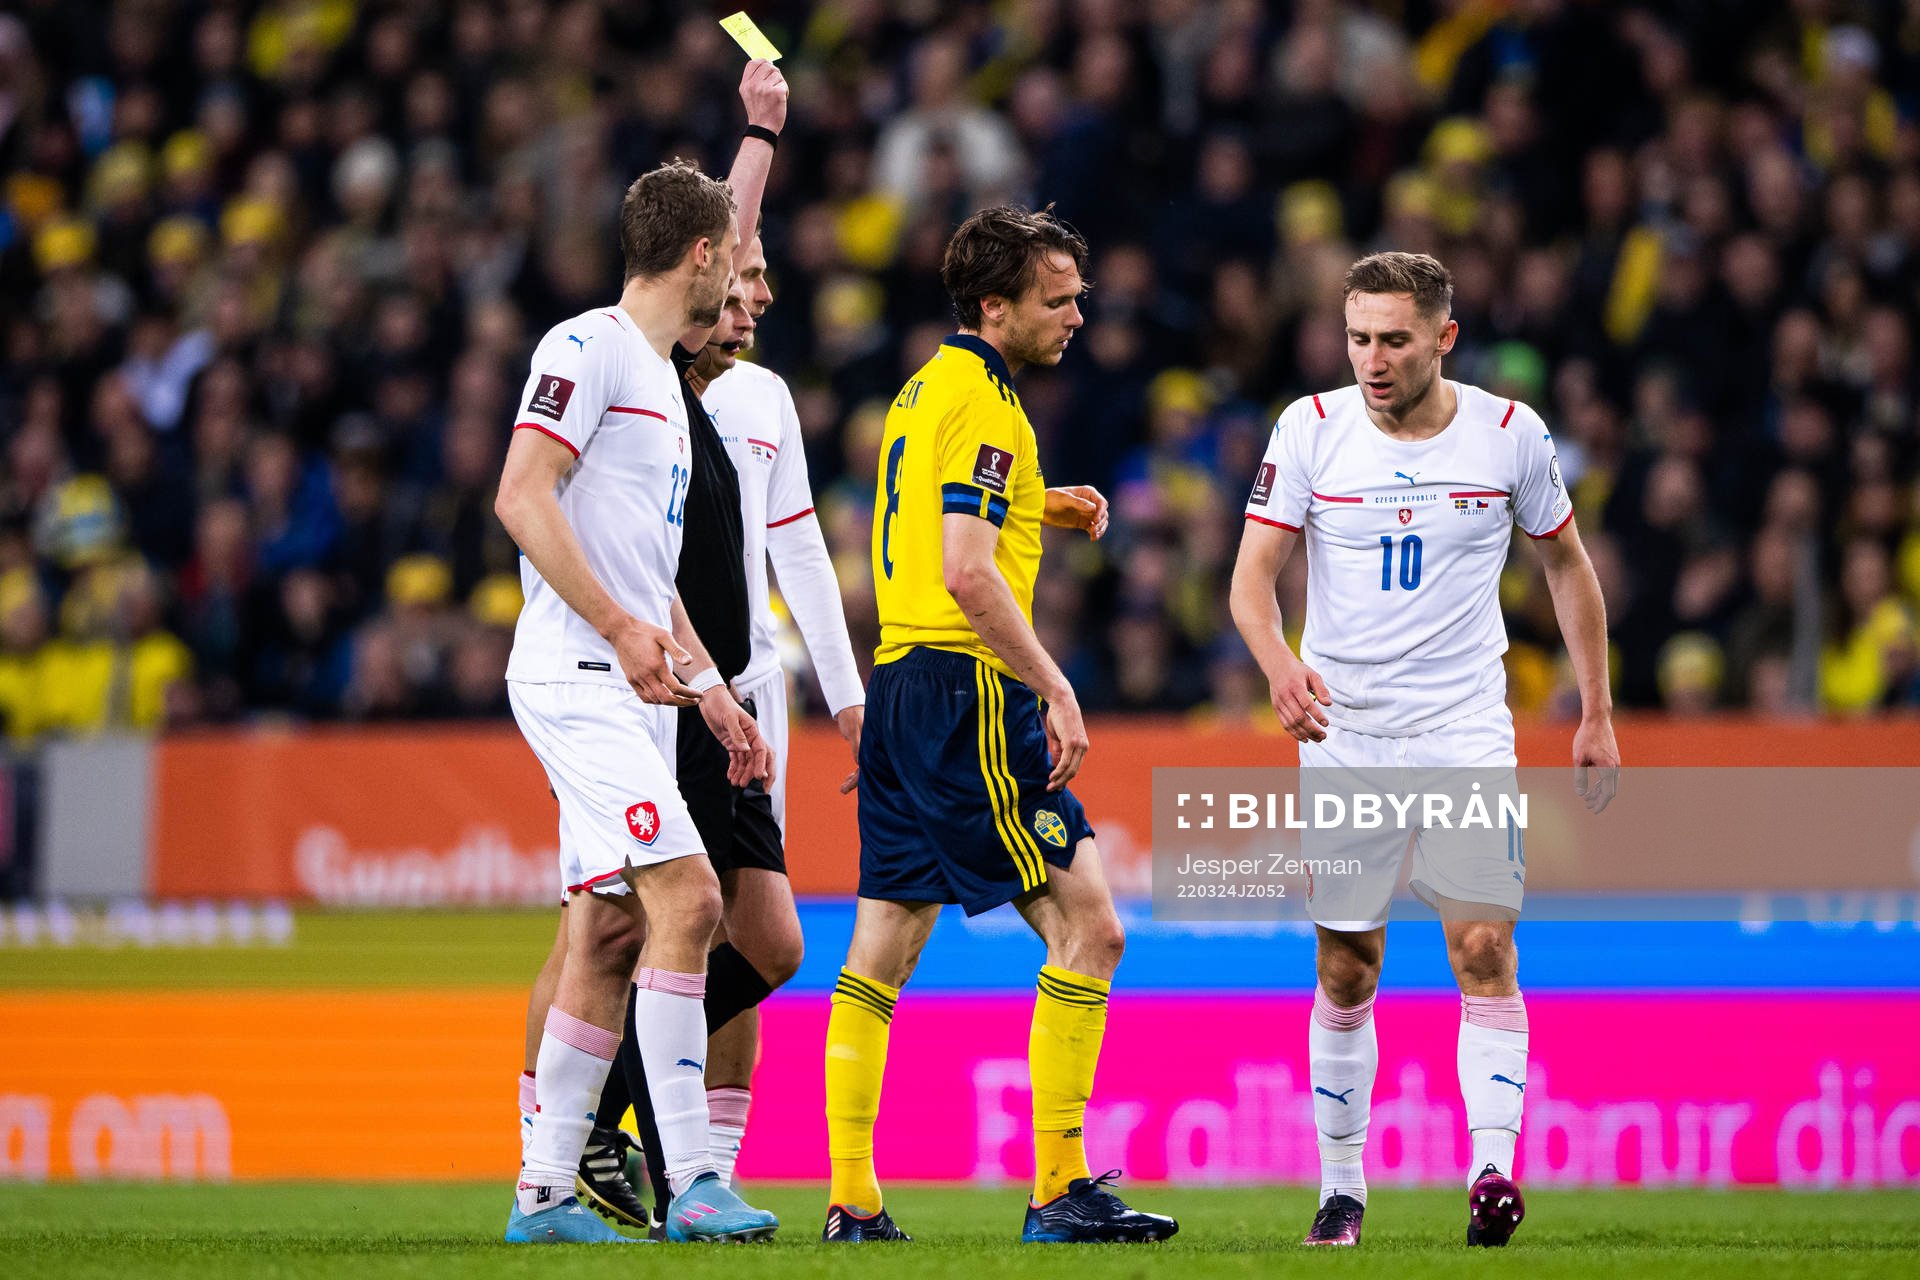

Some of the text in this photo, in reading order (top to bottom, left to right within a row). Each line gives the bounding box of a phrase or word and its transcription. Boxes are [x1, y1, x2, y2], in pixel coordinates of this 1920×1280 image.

[883, 435, 906, 580] 8
[1380, 534, 1423, 591] 10
[68, 1091, 233, 1183] om
